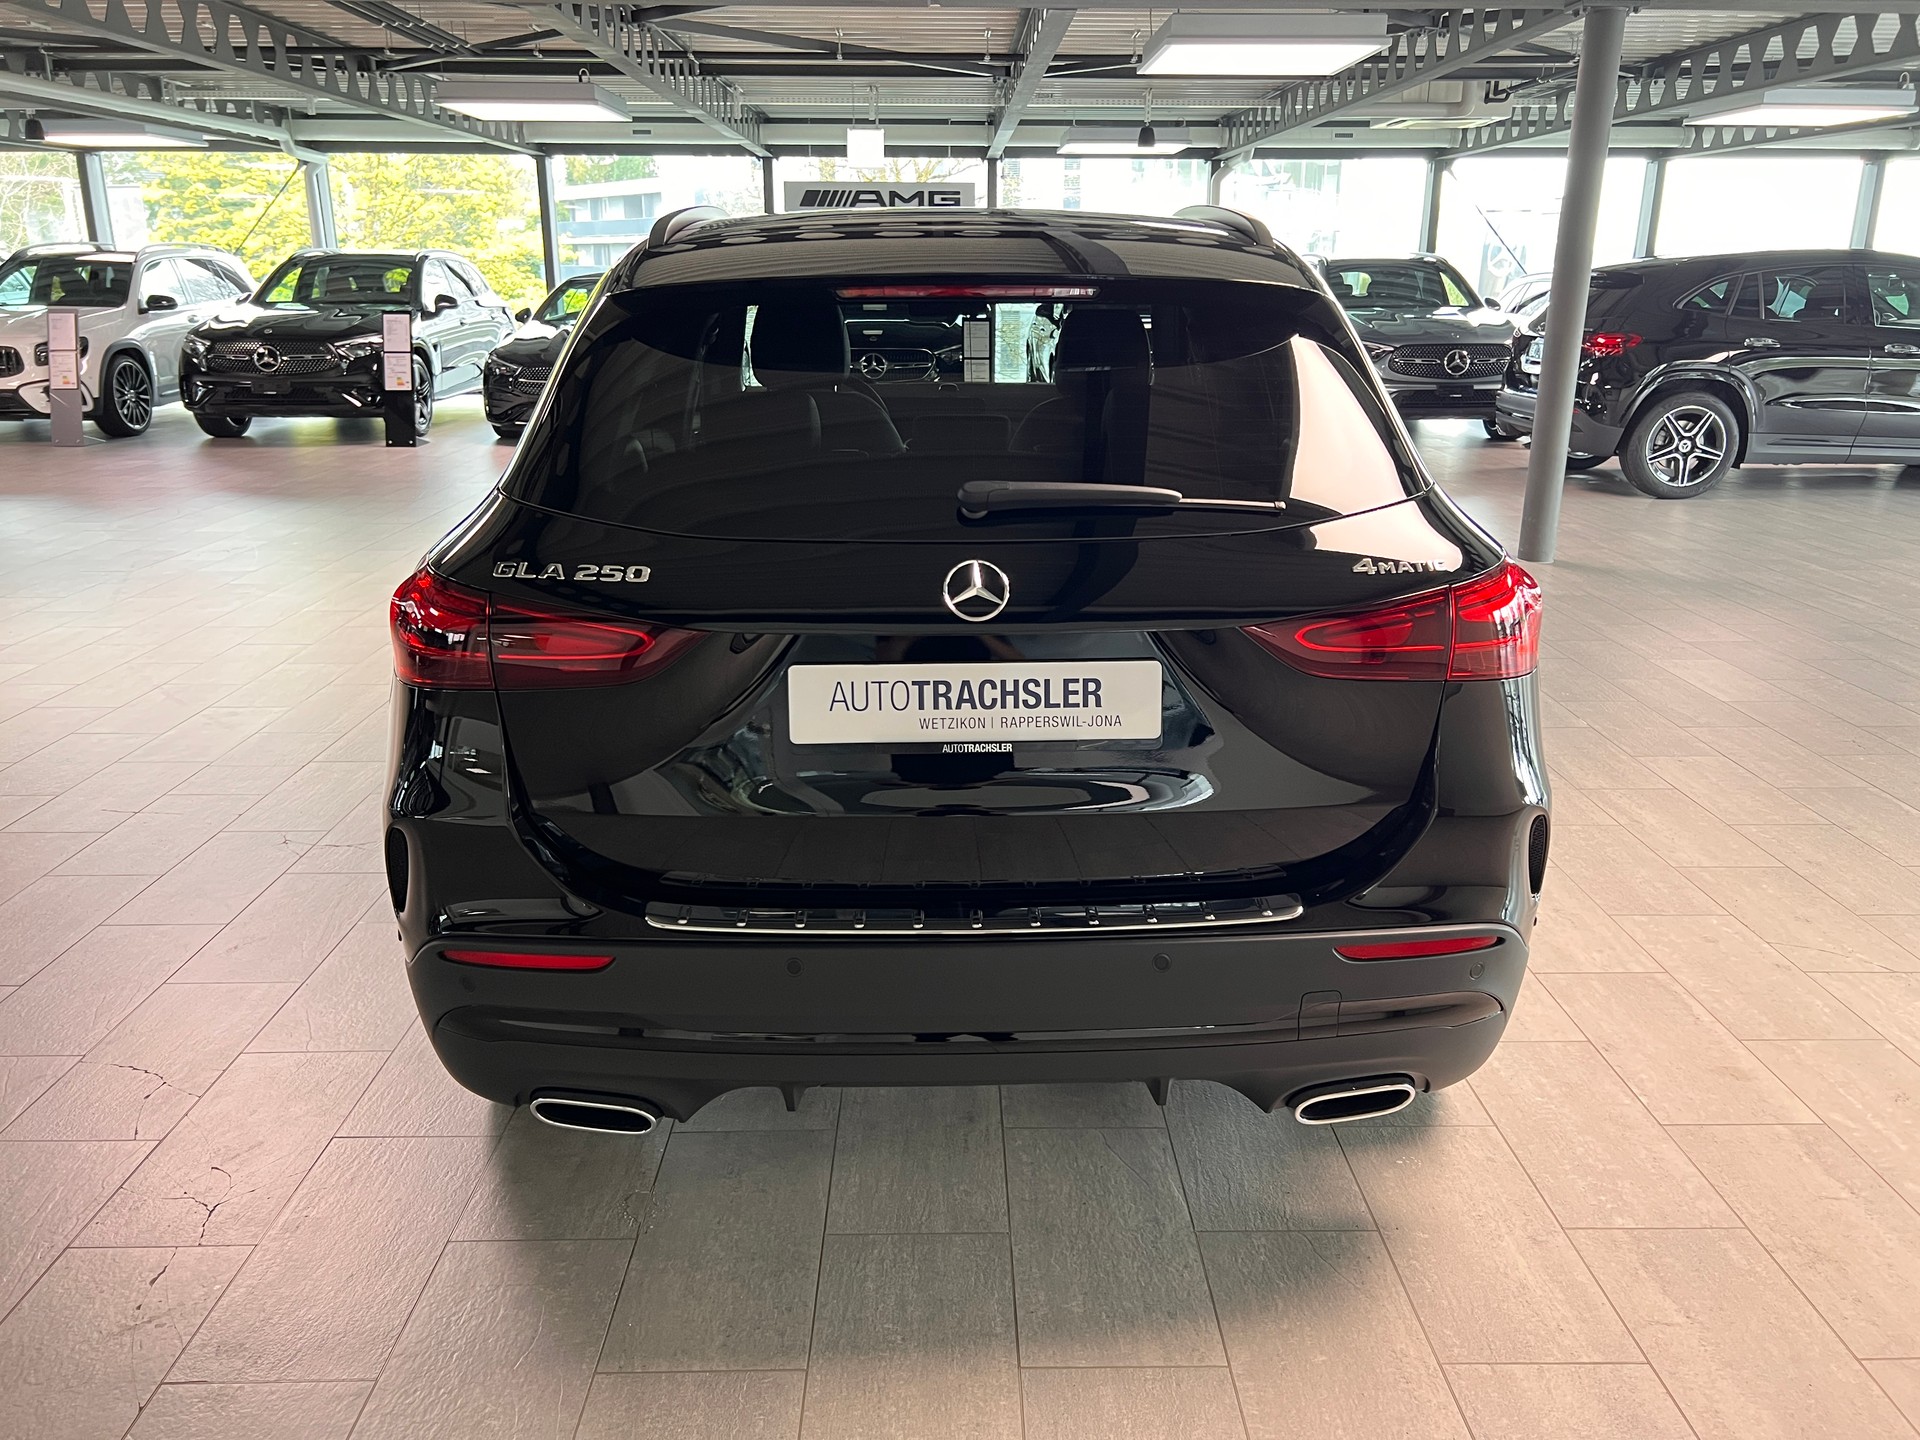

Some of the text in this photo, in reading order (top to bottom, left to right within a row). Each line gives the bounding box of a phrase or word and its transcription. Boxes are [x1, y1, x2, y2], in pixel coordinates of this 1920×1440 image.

[849, 190, 961, 207] AMG
[492, 561, 651, 583] GLA 250
[829, 677, 1103, 712] AUTOTRACHSLER
[919, 714, 1123, 730] WETZIKON RAPPERSWIL-JONA
[942, 743, 1013, 753] AUTOTRACHSLER
